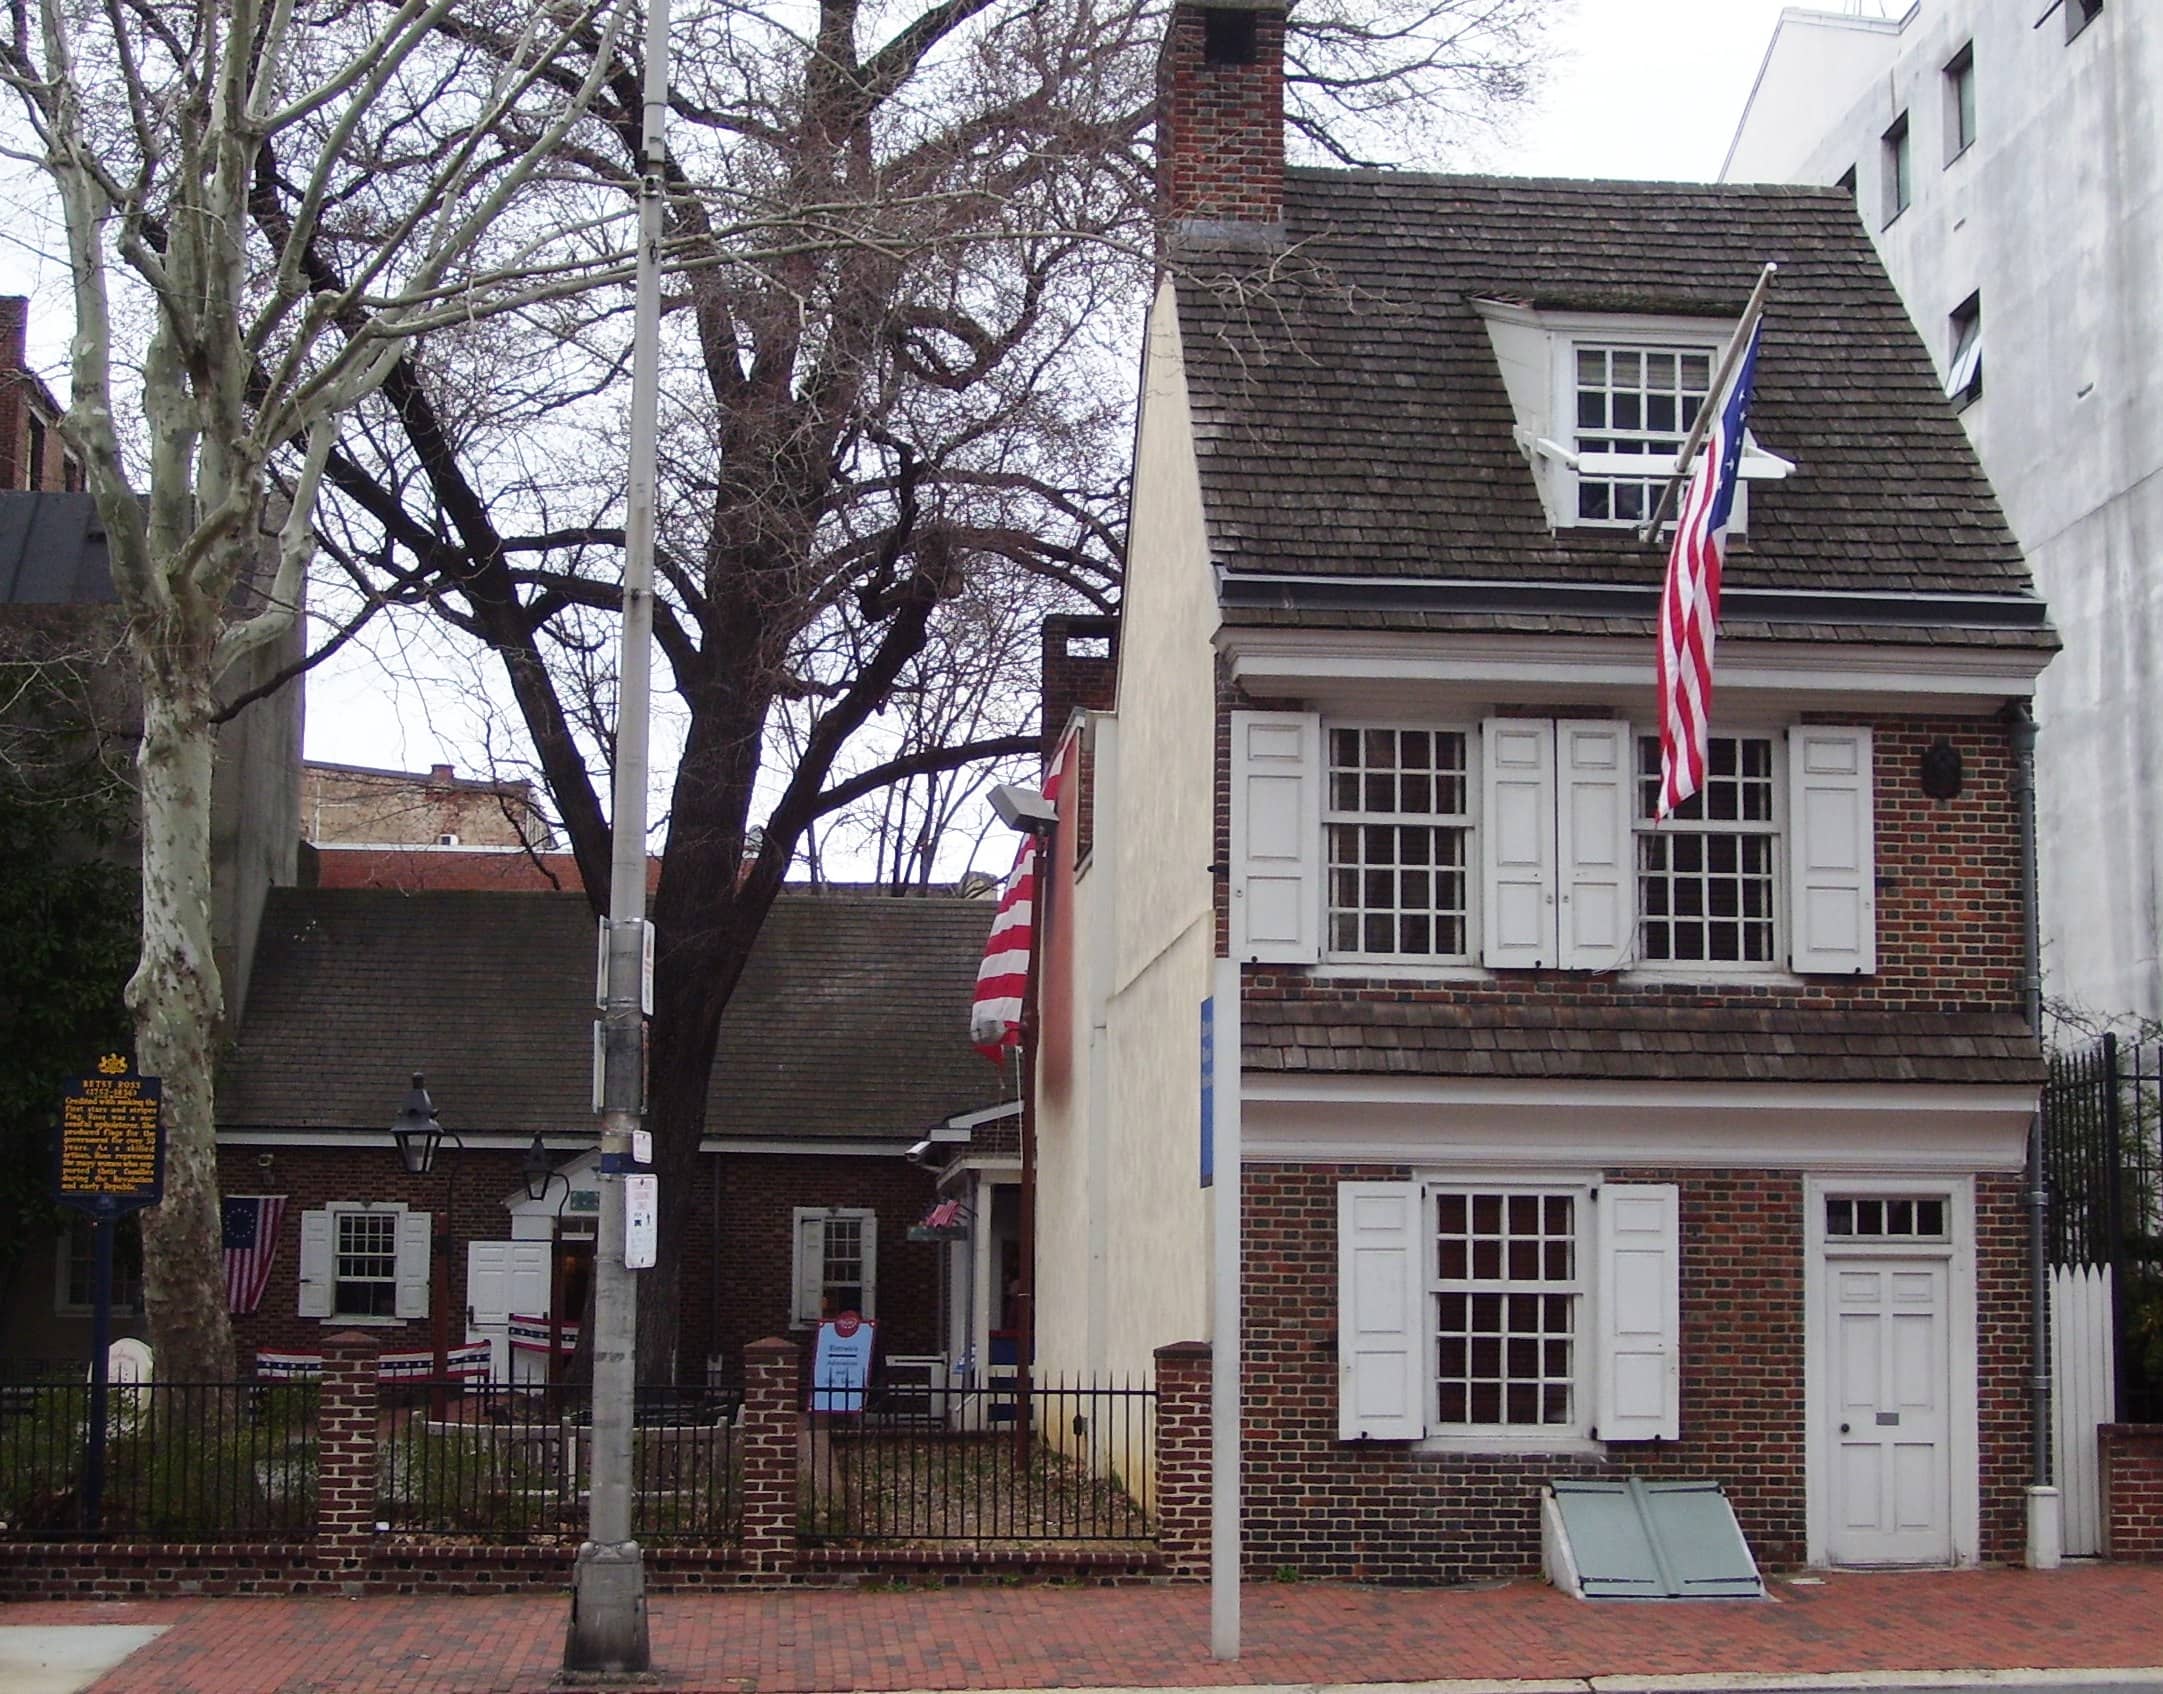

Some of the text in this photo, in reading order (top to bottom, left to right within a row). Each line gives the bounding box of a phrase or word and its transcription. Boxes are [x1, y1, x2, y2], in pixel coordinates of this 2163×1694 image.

[83, 1080, 141, 1089] BETSY ROSS
[99, 1097, 115, 1105] with
